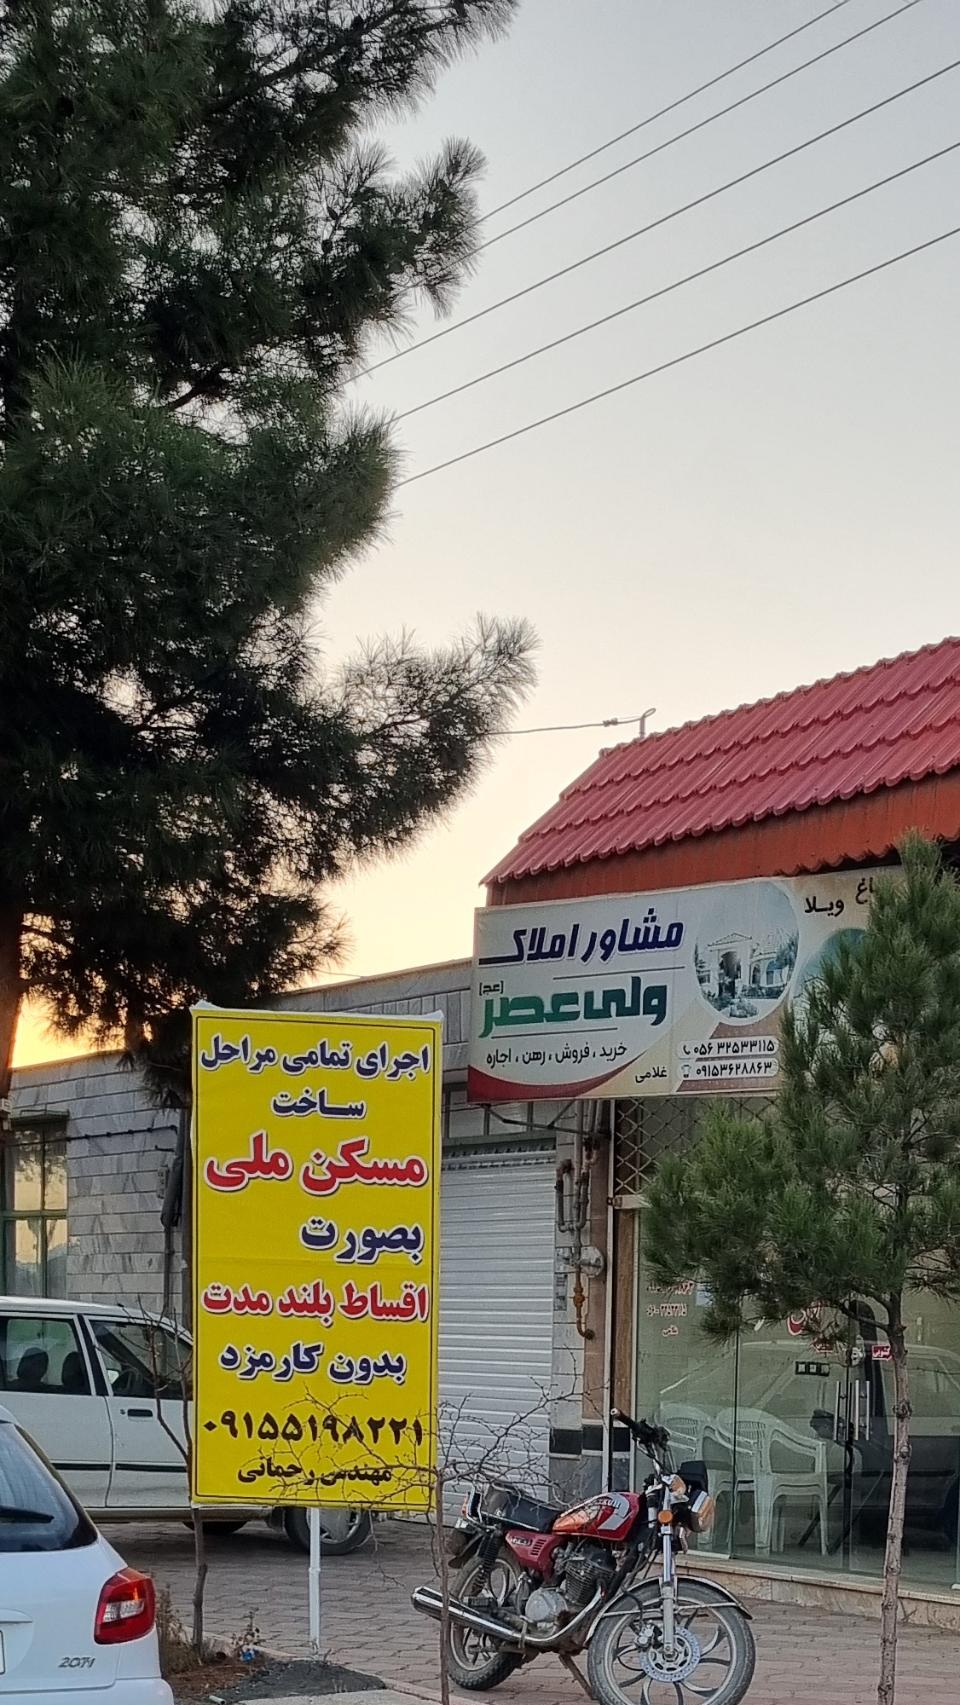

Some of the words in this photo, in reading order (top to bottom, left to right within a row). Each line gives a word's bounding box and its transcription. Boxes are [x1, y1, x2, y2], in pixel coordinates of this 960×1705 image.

[804, 896, 844, 917] ویلا
[856, 877, 875, 904] اغ
[479, 923, 580, 966] املاک
[580, 908, 684, 963] مشاور
[479, 991, 580, 1038] عصر
[584, 976, 667, 1026] ولی
[201, 1034, 277, 1071] مراحل
[282, 1039, 350, 1073] تمامی
[356, 1042, 430, 1079] اجرای
[486, 1049, 512, 1069] اجاره
[522, 1051, 546, 1066] رهن
[555, 1042, 590, 1064] فروش
[599, 1042, 628, 1062] خرید
[635, 1066, 667, 1083] غلامی
[272, 1088, 365, 1117] ساخت
[206, 1131, 290, 1188] ملی
[302, 1137, 426, 1193] مسکن
[301, 1218, 422, 1262] بصورت
[203, 1284, 272, 1313] مدت
[278, 1280, 333, 1325] بلند
[339, 1281, 429, 1320] اقساط
[329, 1351, 406, 1383] بدون
[203, 1410, 423, 1446] ۰۹۱۵۵۱۹۸۲۲۱
[238, 1456, 315, 1486] رحمانی
[320, 1463, 393, 1486] مهندس
